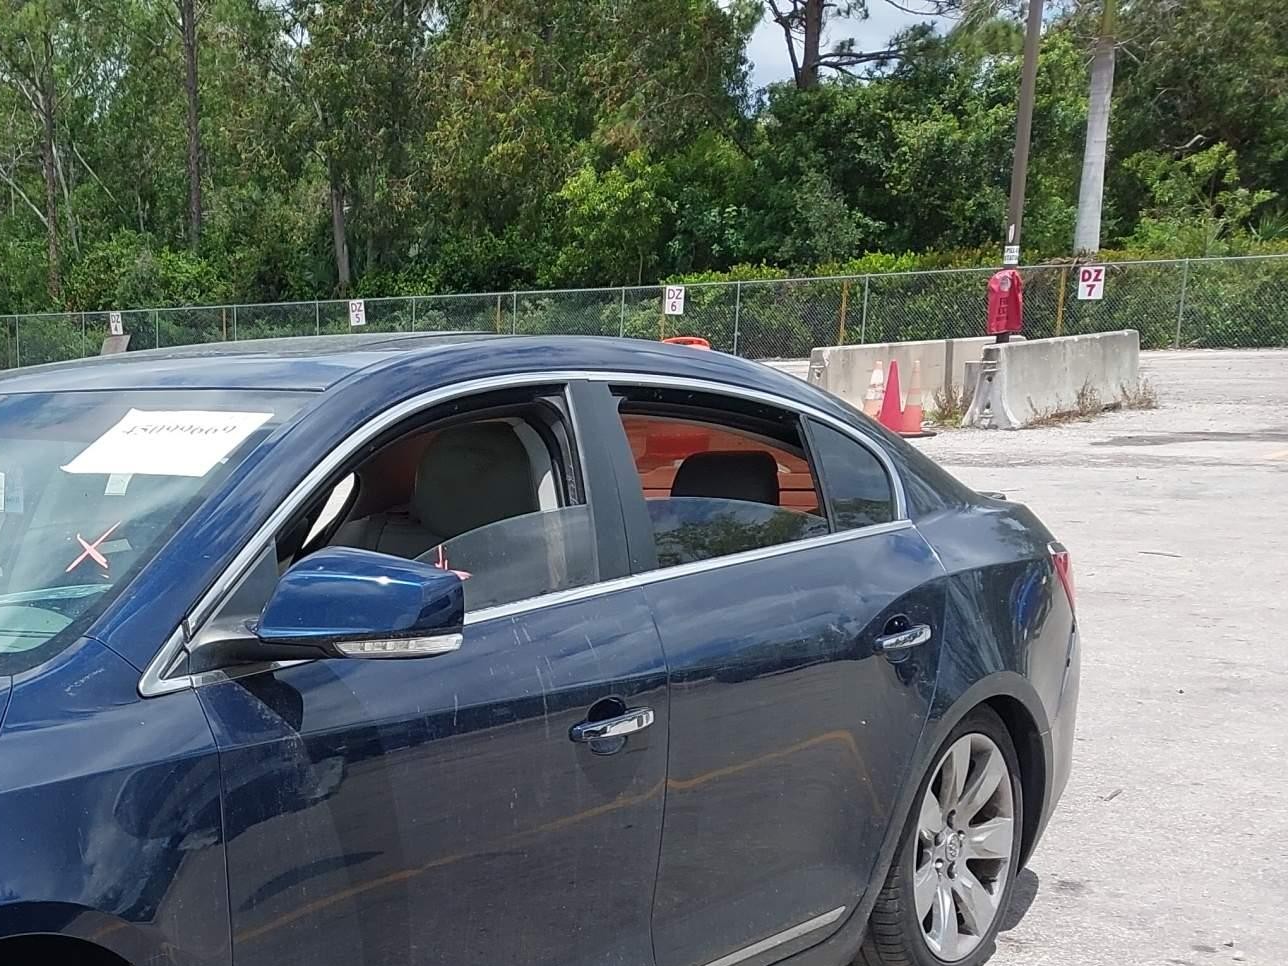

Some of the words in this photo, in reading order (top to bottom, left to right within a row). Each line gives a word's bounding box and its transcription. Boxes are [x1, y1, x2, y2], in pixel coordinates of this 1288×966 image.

[1081, 269, 1103, 282] DZ
[667, 288, 683, 300] DZ
[1086, 284, 1097, 297] 7
[350, 302, 364, 313] DZ
[670, 301, 677, 312] 6
[111, 314, 121, 324] DZ
[355, 313, 361, 323] 5
